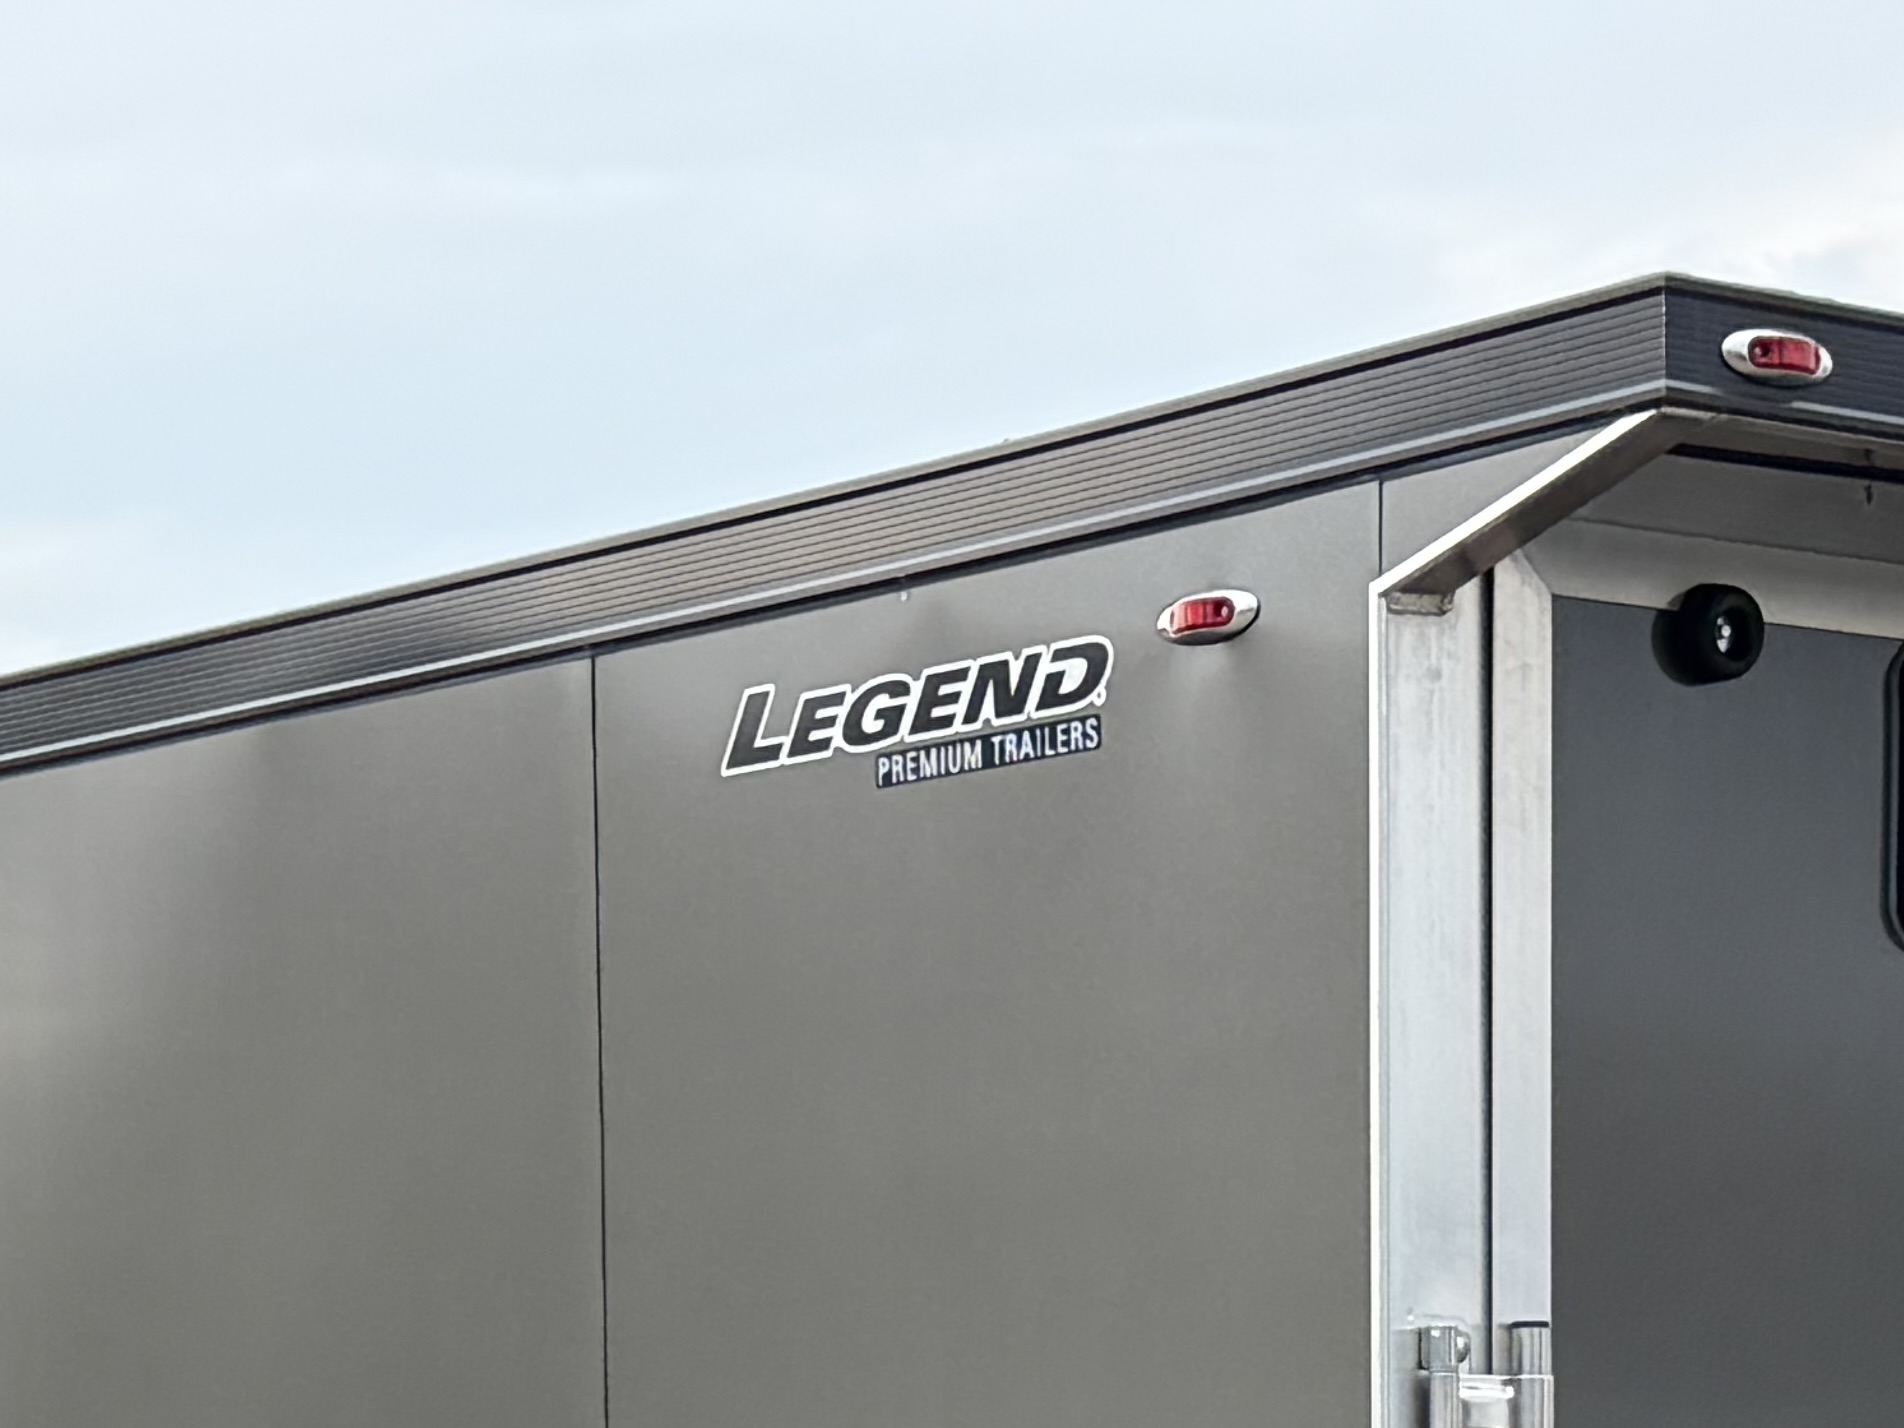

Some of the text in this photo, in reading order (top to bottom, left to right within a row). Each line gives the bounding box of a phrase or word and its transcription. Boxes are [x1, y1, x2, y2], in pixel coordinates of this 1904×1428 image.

[721, 635, 1114, 777] LEGEND
[877, 718, 1099, 786] PREMIUM TRAILERS
